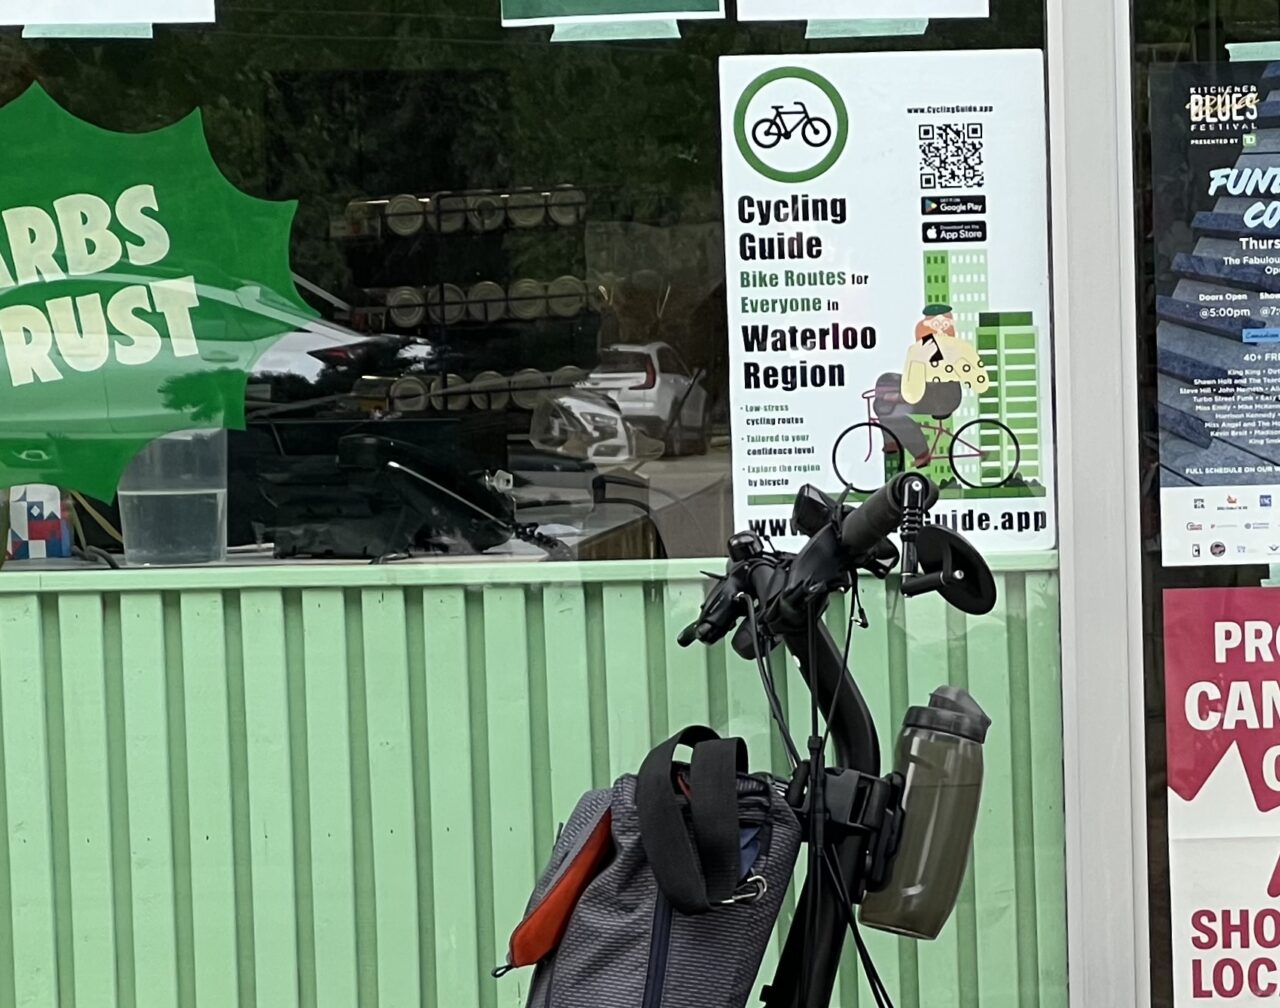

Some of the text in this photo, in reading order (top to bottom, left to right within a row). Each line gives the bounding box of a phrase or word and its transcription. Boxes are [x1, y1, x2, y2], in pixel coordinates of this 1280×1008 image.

[1189, 85, 1257, 94] KITCHENER
[907, 105, 993, 114] www.CyclingGuide.app
[1189, 92, 1258, 123] BLUES
[1190, 122, 1257, 132] FESTIVAL
[737, 194, 847, 226] Cycling
[940, 202, 983, 213] Google Play
[0, 184, 170, 287] RBS
[940, 229, 983, 240] App Store
[739, 232, 822, 261] Guide
[1223, 256, 1242, 265] The
[740, 270, 869, 288] Bike Routes for
[1225, 293, 1248, 302] Open
[1260, 292, 1280, 300] Show
[741, 297, 839, 314] Everyone in
[1200, 308, 1250, 319] @5:00pm
[742, 323, 877, 353] Waterloo
[1243, 353, 1262, 362] 40+
[744, 361, 845, 391] Region
[746, 417, 804, 426] cycling routes
[746, 434, 809, 443] Tailored your
[747, 446, 815, 456] confidence level
[748, 463, 820, 474] Explore region
[1185, 467, 1203, 475] FULL
[1205, 466, 1242, 475] SCHEDULE
[760, 478, 789, 487] bicycle
